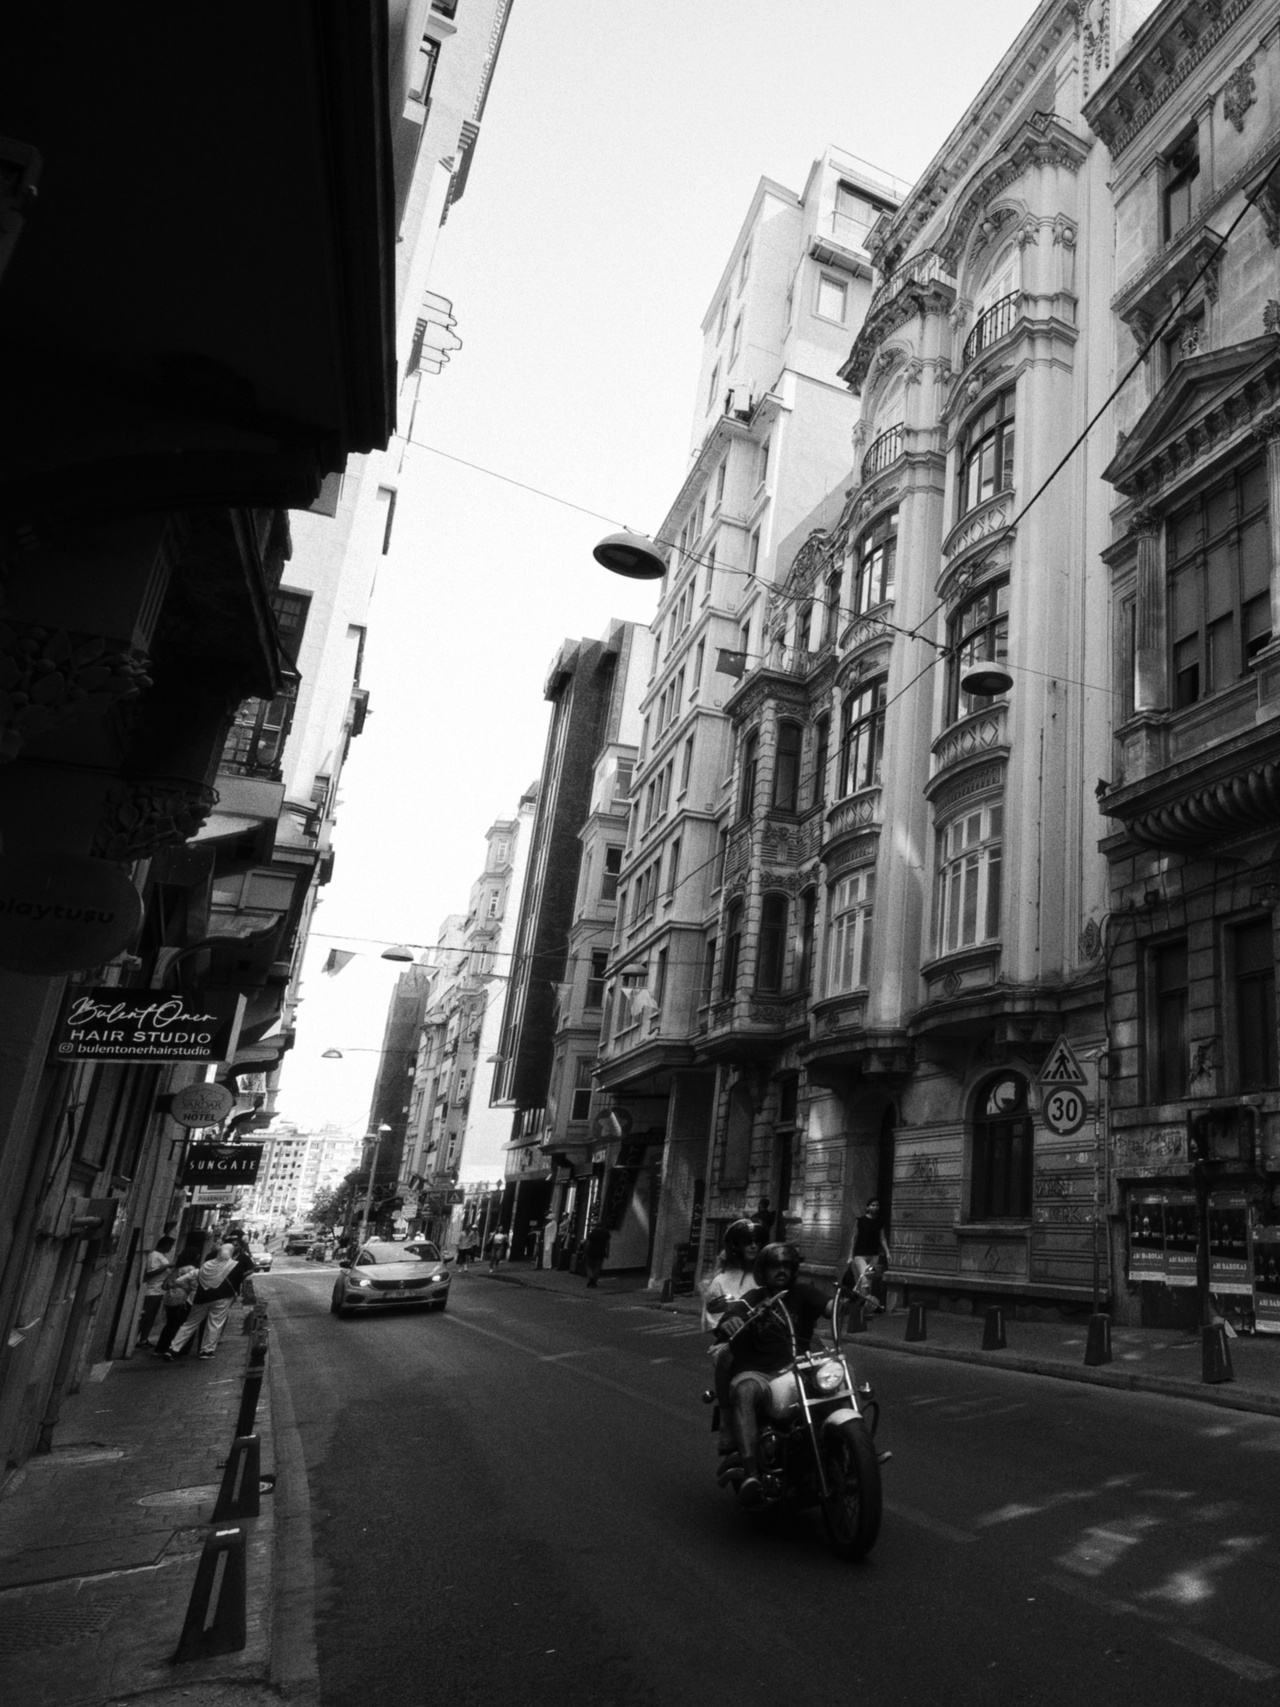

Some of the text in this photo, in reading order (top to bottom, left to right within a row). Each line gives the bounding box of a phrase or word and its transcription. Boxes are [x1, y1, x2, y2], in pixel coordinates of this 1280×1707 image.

[70, 1029, 211, 1044] HAIR STUDIO
[77, 1044, 211, 1056] bulentonerhairstudio
[1052, 1097, 1078, 1122] 30
[183, 1113, 217, 1121] HOTEL
[189, 1160, 257, 1170] SUNGATE
